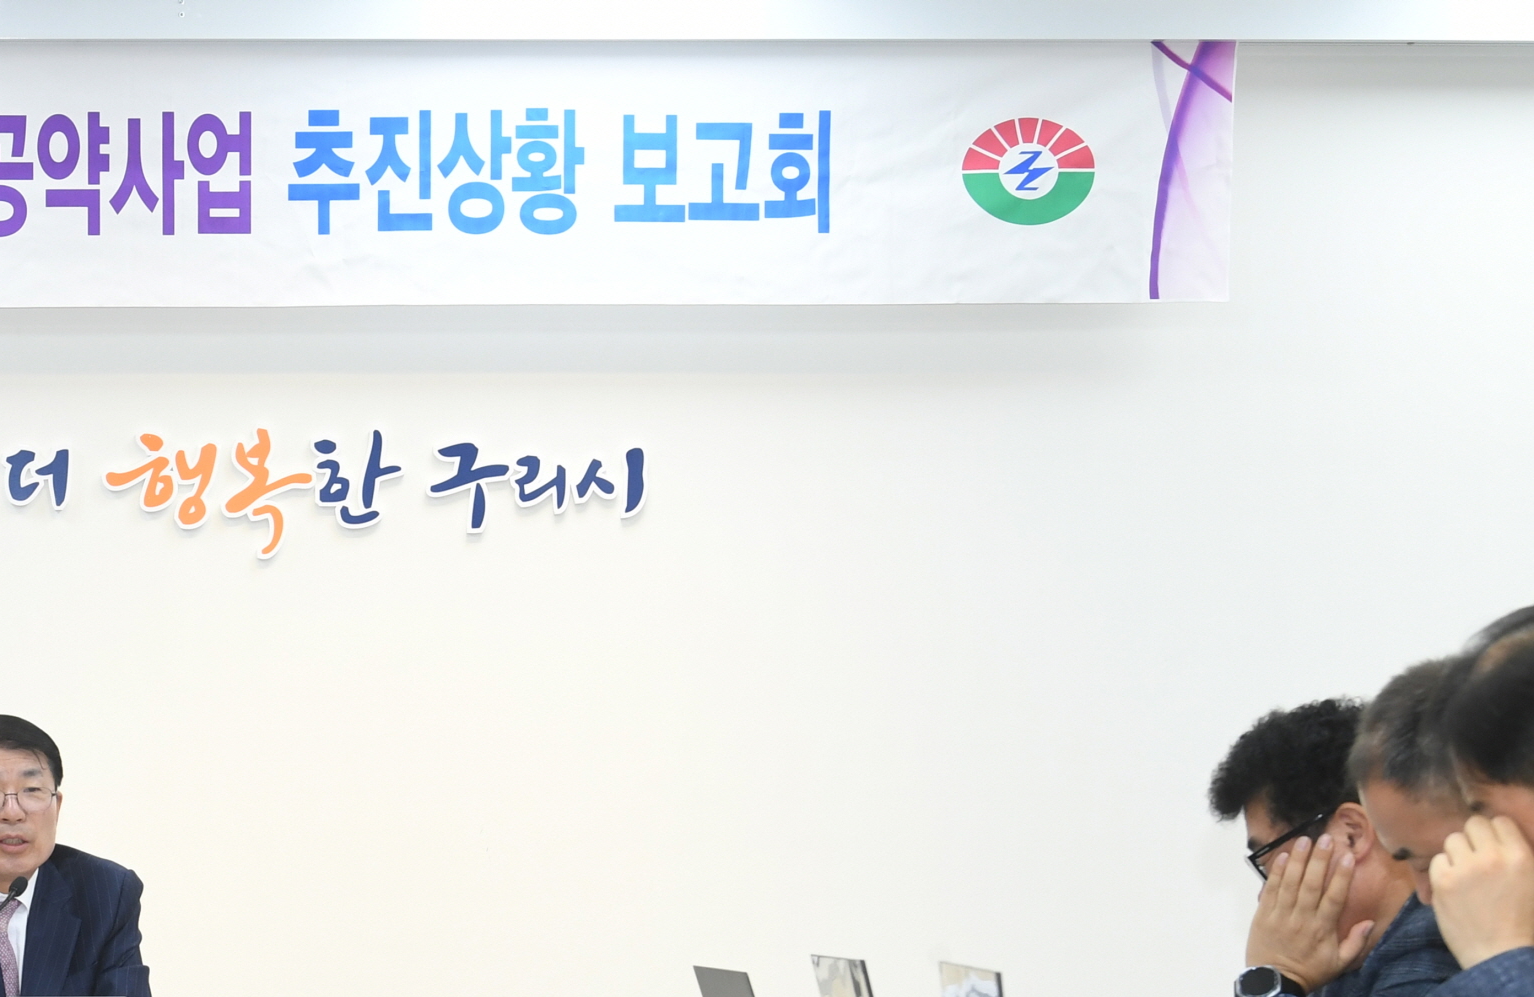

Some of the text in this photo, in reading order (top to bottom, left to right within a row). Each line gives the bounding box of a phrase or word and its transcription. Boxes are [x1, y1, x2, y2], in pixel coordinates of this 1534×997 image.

[287, 107, 585, 236] 추진상황
[613, 109, 832, 234] 보고회
[5, 448, 70, 508] 더
[105, 427, 403, 555] 행복한
[429, 442, 645, 530] 구리시
